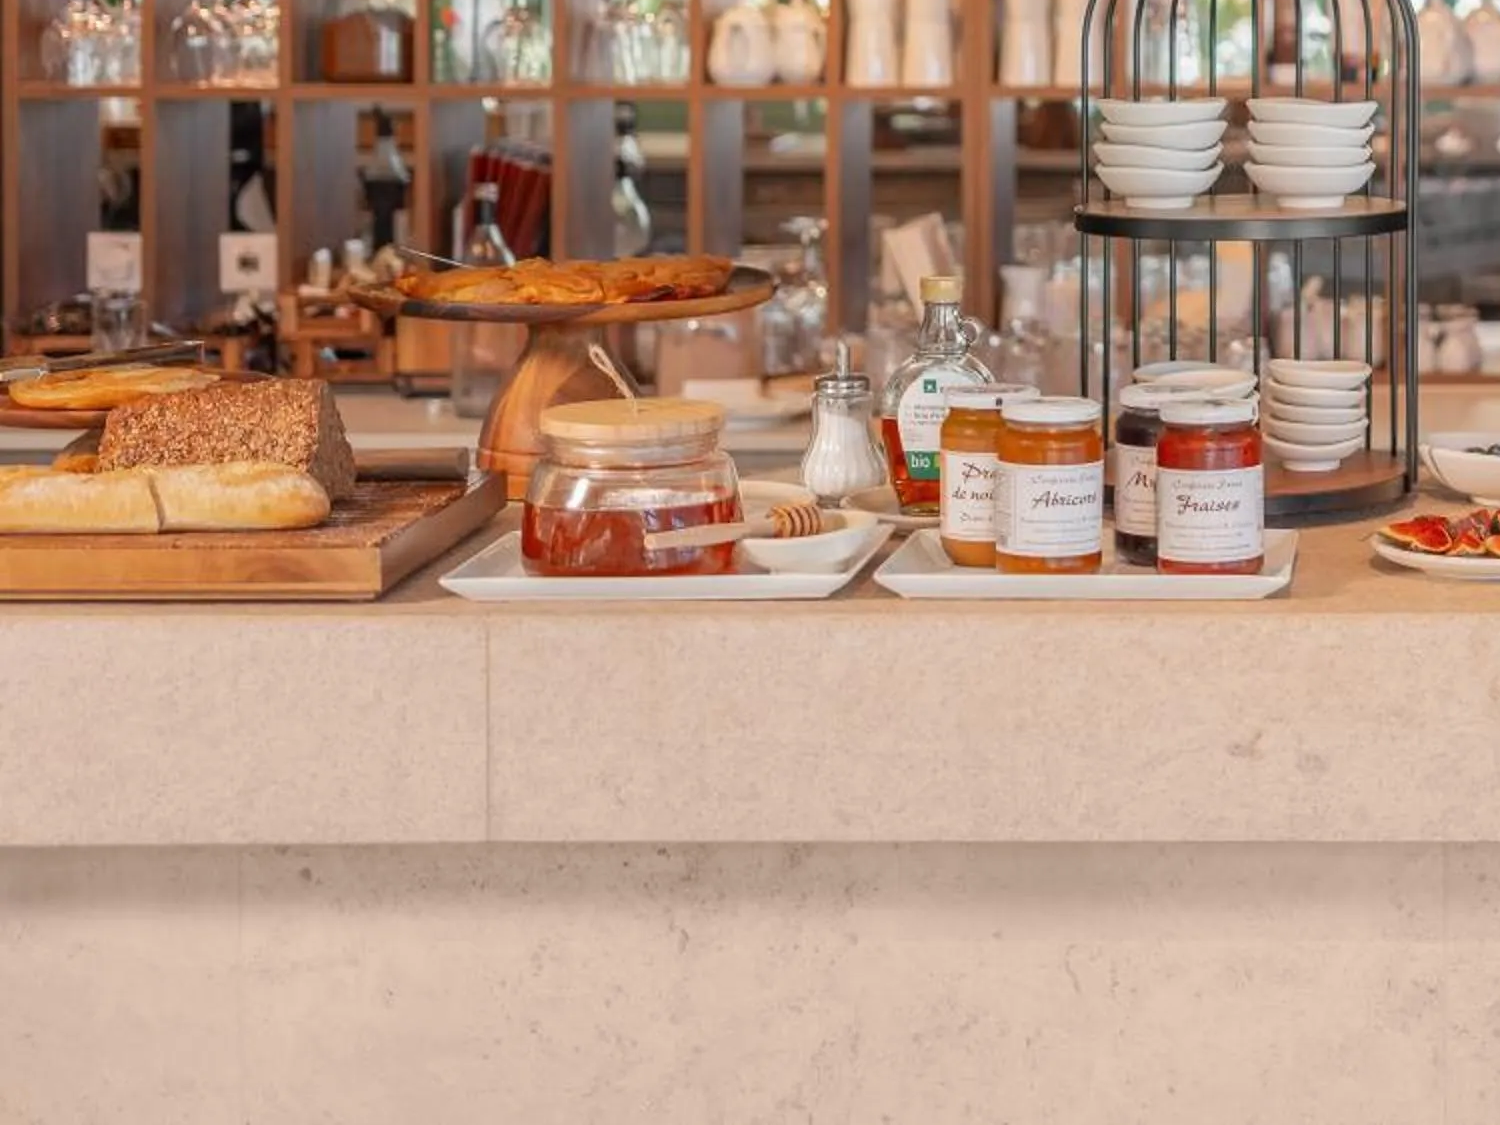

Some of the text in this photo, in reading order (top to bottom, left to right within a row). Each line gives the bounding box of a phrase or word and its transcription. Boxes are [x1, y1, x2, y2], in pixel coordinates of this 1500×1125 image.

[911, 453, 932, 468] bio
[951, 486, 967, 501] de
[1175, 494, 1241, 516] Fraises
